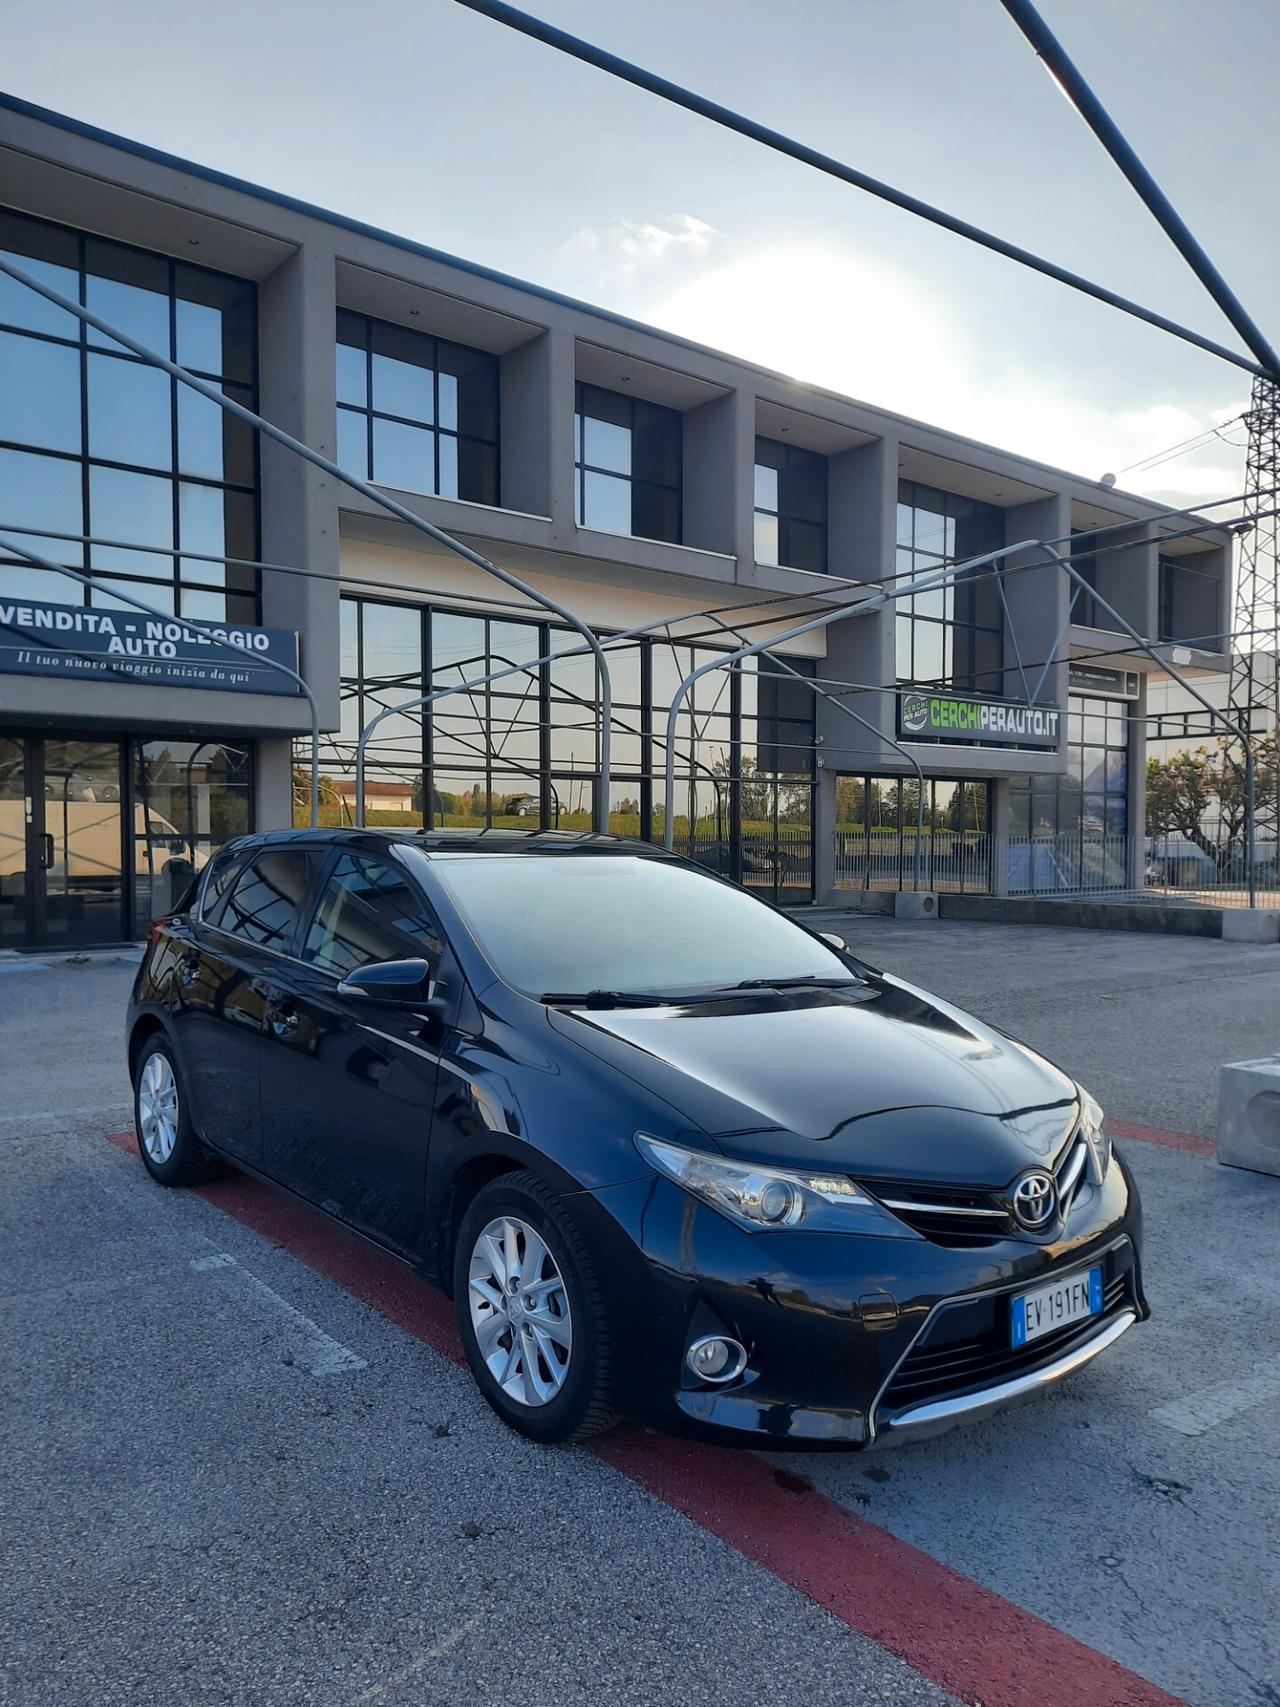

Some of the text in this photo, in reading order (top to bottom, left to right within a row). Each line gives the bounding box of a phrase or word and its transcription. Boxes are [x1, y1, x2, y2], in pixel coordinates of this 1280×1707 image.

[0, 605, 117, 635] VENDITA
[146, 621, 270, 651] NOLEGGIO
[107, 636, 177, 658] AUTO
[17, 651, 250, 684] Il tuo nuovo viaggio inizia da qui
[903, 700, 928, 715] CERCHI
[914, 708, 928, 718] AUTO
[1049, 1281, 1090, 1322] 191FN
